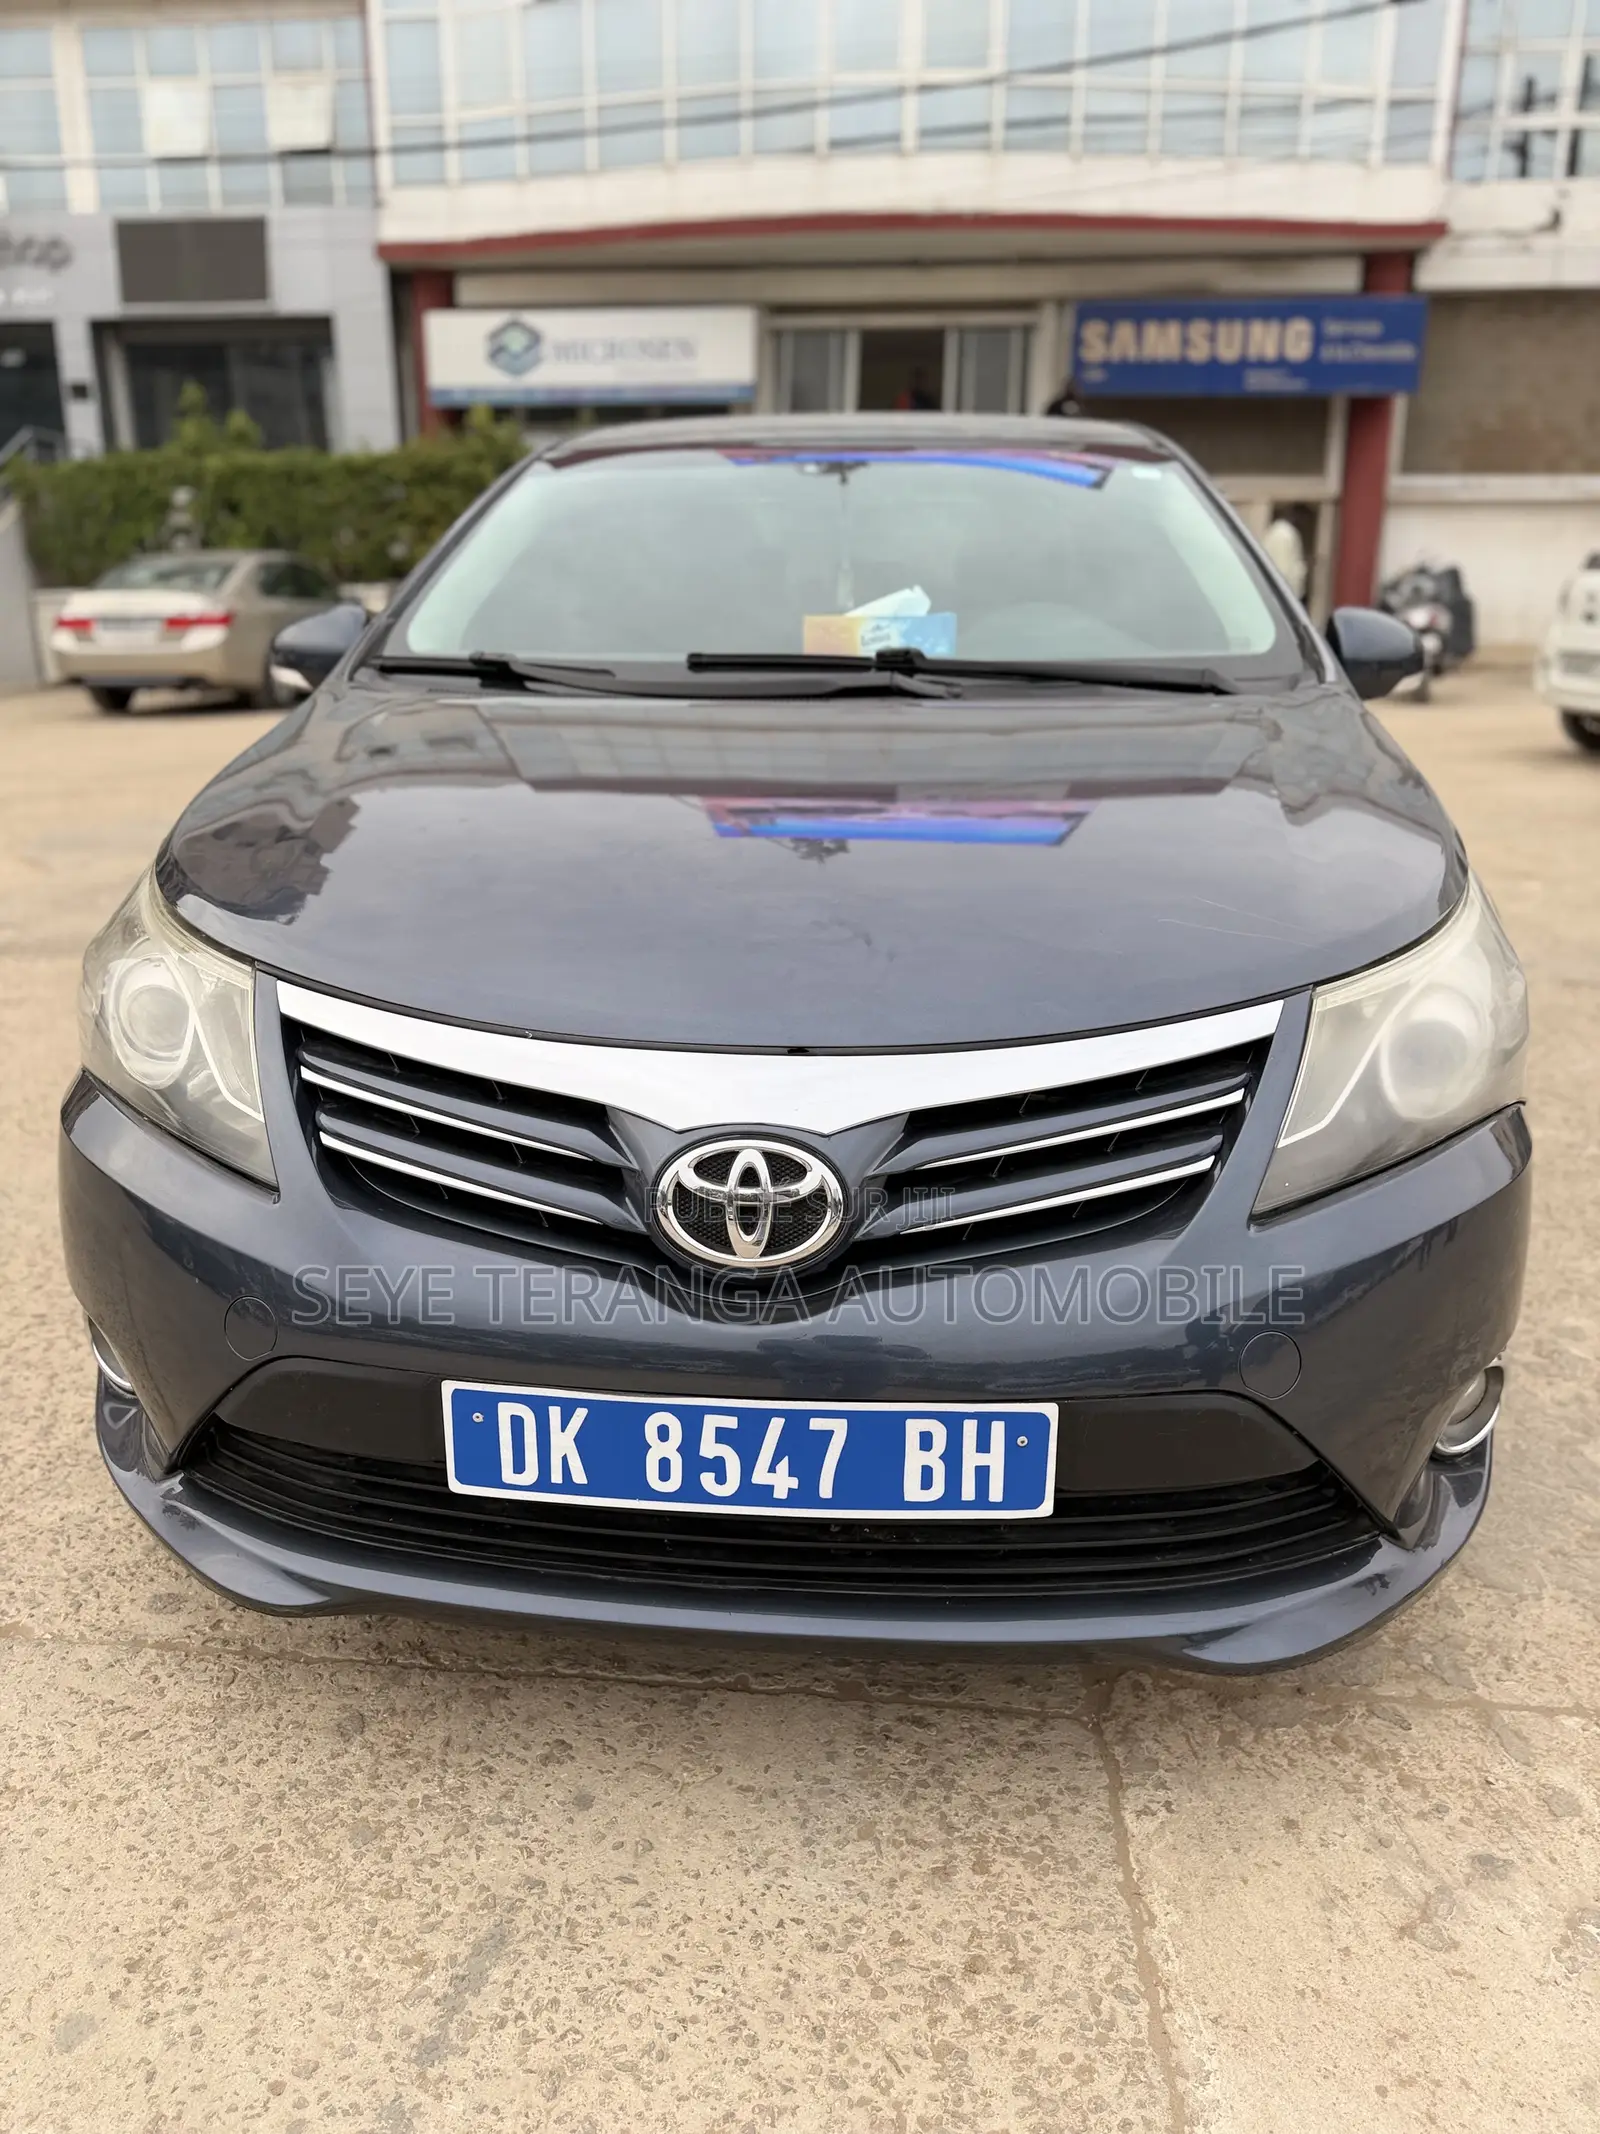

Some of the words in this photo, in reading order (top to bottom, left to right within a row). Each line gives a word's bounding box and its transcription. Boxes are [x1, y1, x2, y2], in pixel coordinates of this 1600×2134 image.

[1080, 317, 1314, 364] SAMSUNG
[498, 1402, 589, 1486] DK
[644, 1411, 849, 1499] 8547
[903, 1418, 1006, 1503] BH
